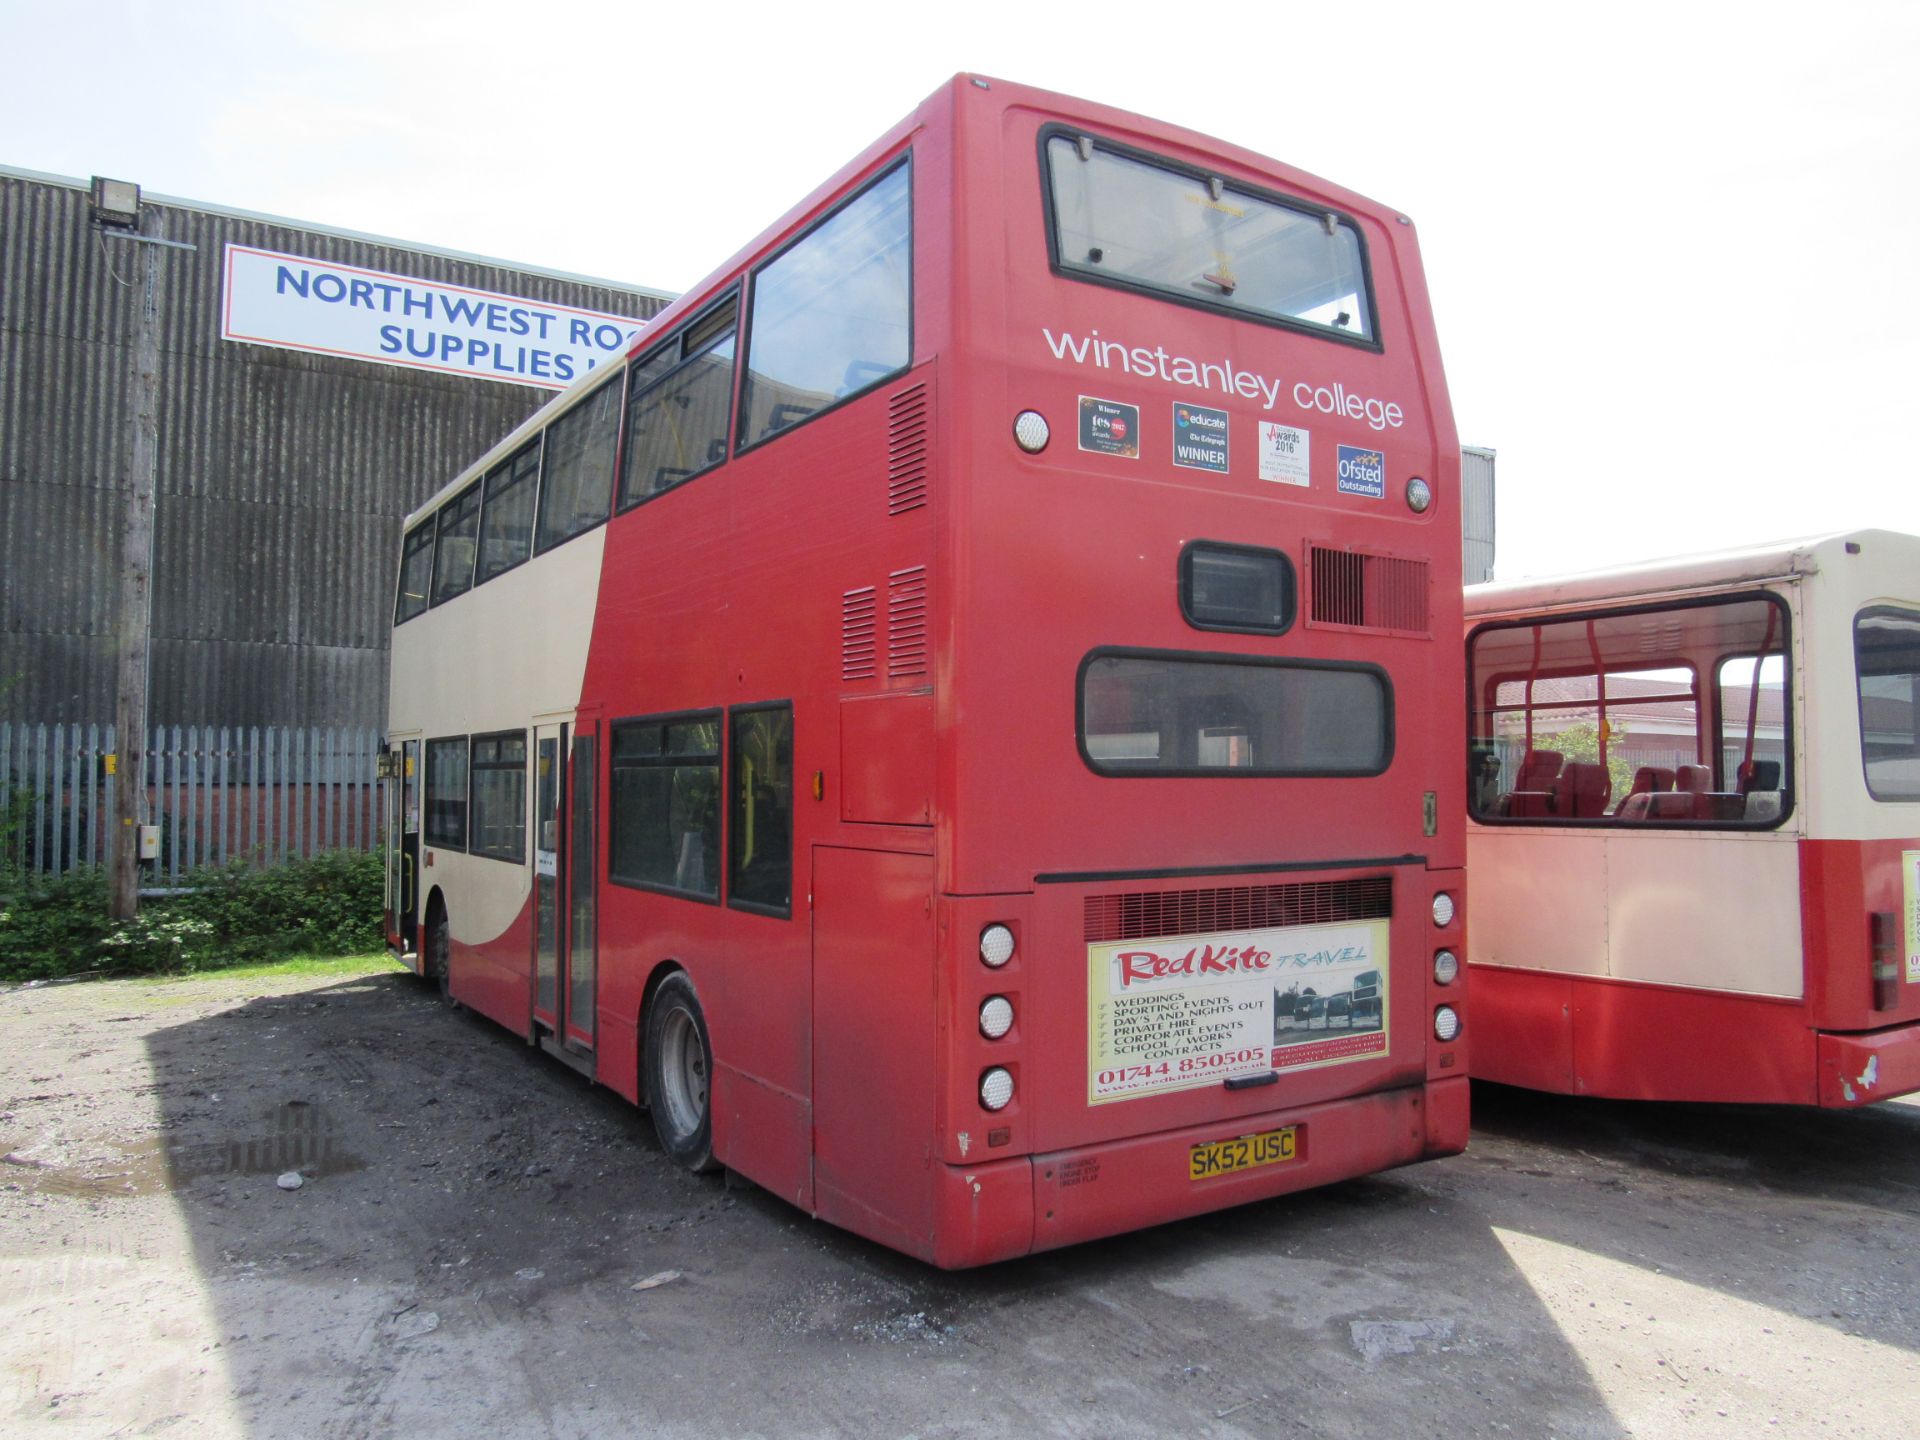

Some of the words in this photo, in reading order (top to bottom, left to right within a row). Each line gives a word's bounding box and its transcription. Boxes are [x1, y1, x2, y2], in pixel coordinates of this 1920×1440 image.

[570, 318, 638, 351] RO
[379, 325, 575, 382] SUPPLIES
[1042, 329, 1280, 410] winstanley
[1293, 382, 1404, 431] college
[1190, 414, 1225, 429] educate
[1190, 433, 1200, 441] The
[1201, 435, 1225, 446] Telegraph
[1267, 425, 1300, 444] Awards
[1178, 445, 1225, 465] WINNER
[1276, 440, 1295, 453] 2016
[1339, 460, 1381, 483] Ofsted
[1339, 479, 1381, 497] Outstanding
[1278, 946, 1367, 968] TRAVEL
[1114, 993, 1185, 1008] WEDDINGS
[1114, 1002, 1179, 1017] SPORTING
[1184, 996, 1230, 1009] EVENTS
[1114, 1015, 1150, 1027] DAY'S
[1156, 1011, 1184, 1022] AND
[1189, 1004, 1234, 1016] NIGHTS
[1238, 1000, 1264, 1011] OUT
[1114, 1022, 1164, 1036] PRIVATE
[1169, 1018, 1197, 1029] HIRE
[1114, 1028, 1194, 1046] CORPORATE
[1199, 1021, 1244, 1034] EVENTS
[1114, 1041, 1169, 1055] SCHOOL
[1187, 1031, 1232, 1044] WORKS
[1144, 1042, 1222, 1060] CONTRACTS
[1097, 1061, 1266, 1094] www.redkitetravel.co.uk
[1098, 1062, 1171, 1085] 01744
[1179, 1048, 1264, 1073] 850505
[1192, 1143, 1249, 1175] SK52
[1254, 1133, 1292, 1162] USC
